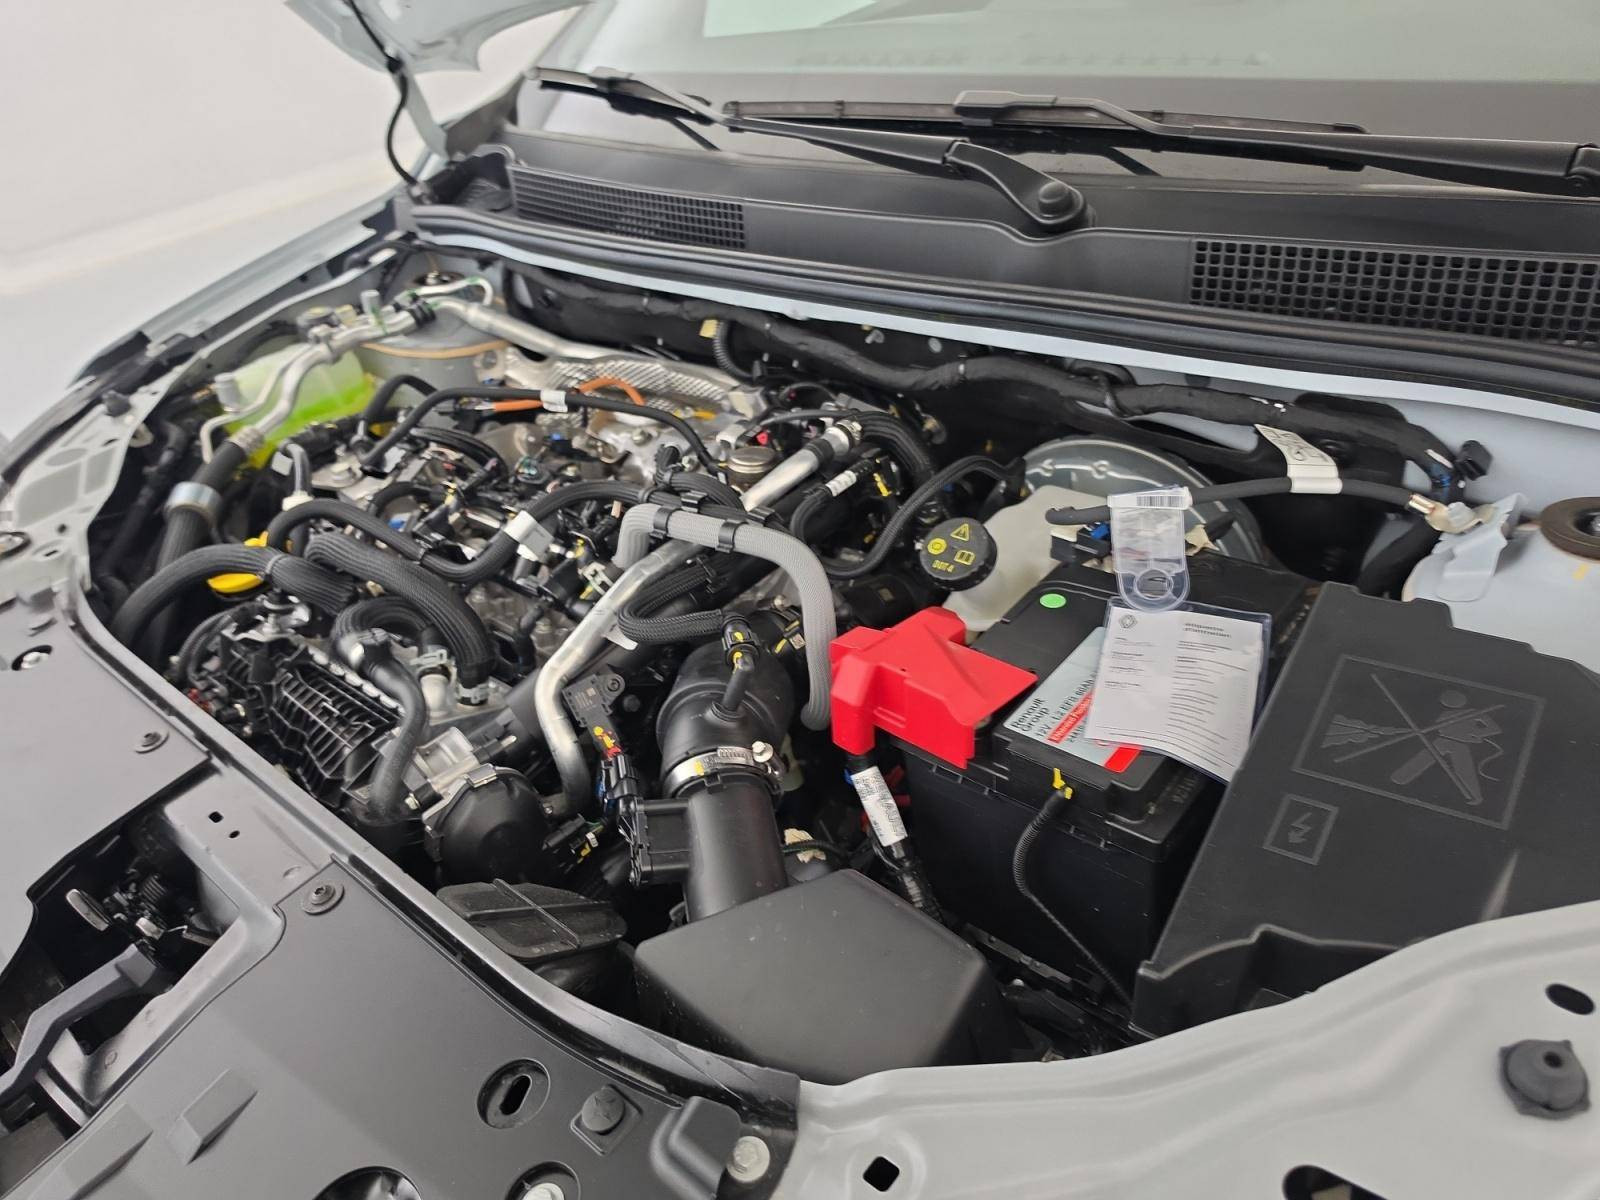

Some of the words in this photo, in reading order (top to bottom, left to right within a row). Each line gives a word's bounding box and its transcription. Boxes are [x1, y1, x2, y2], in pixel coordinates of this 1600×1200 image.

[1010, 698, 1045, 728] Renault
[1020, 707, 1049, 731] Group
[1035, 722, 1052, 737] 12V
